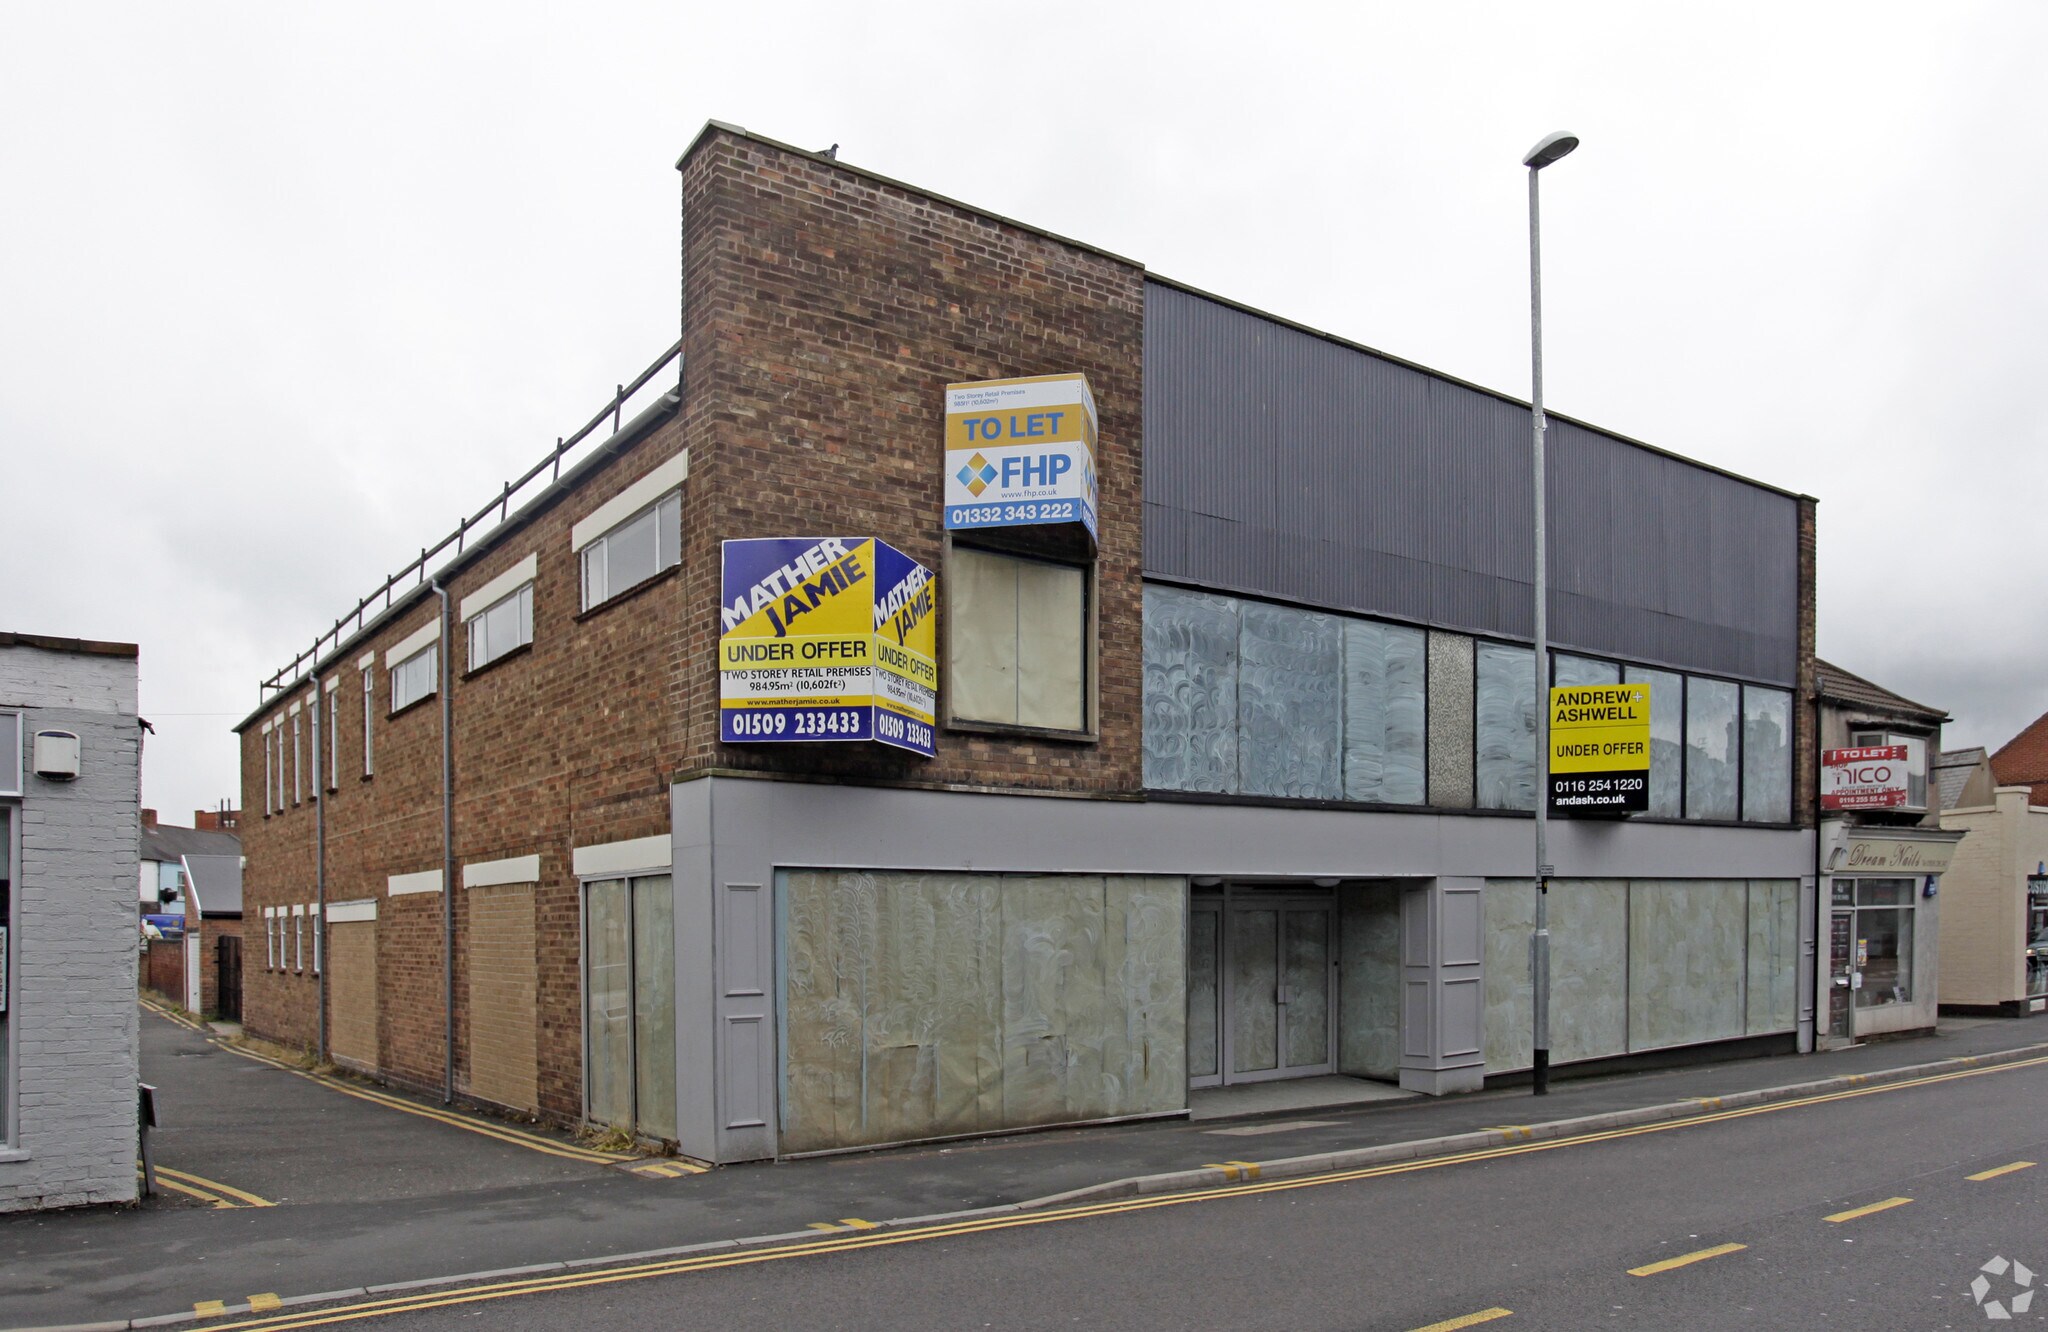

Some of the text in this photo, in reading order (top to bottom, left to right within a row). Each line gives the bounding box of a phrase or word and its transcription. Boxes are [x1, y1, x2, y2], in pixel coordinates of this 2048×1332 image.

[963, 417, 1002, 441] TO
[1010, 412, 1064, 438] LET
[1002, 454, 1071, 488] FHP
[1001, 488, 1057, 498] www.fhp.co.uk
[952, 502, 1072, 524] 01332 343 222
[722, 538, 850, 632] MATHER
[765, 554, 867, 638] JAMIE
[874, 564, 927, 630] MATHER
[895, 585, 933, 646] JAMIE
[728, 641, 866, 662] UNDER OFFER
[725, 667, 871, 680] TWO STOREY RETAIL PREMISES
[878, 644, 934, 682] UNDER OFFER
[750, 680, 846, 692] 984.95m² (10,602ft²)
[875, 668, 886, 680] TWO
[888, 673, 904, 685] STOREY
[1556, 691, 1631, 706] ANDREW
[733, 712, 859, 735] 01509 233433
[1556, 707, 1637, 722] ASHWELL
[880, 714, 931, 748] 01509 233433
[1556, 742, 1643, 757] UNDER OFFER
[1863, 749, 1888, 757] LET
[1556, 779, 1643, 792] 0116 254 1220
[1556, 794, 1625, 805] andash.co.uk
[1848, 844, 1920, 866] Dream Nails
